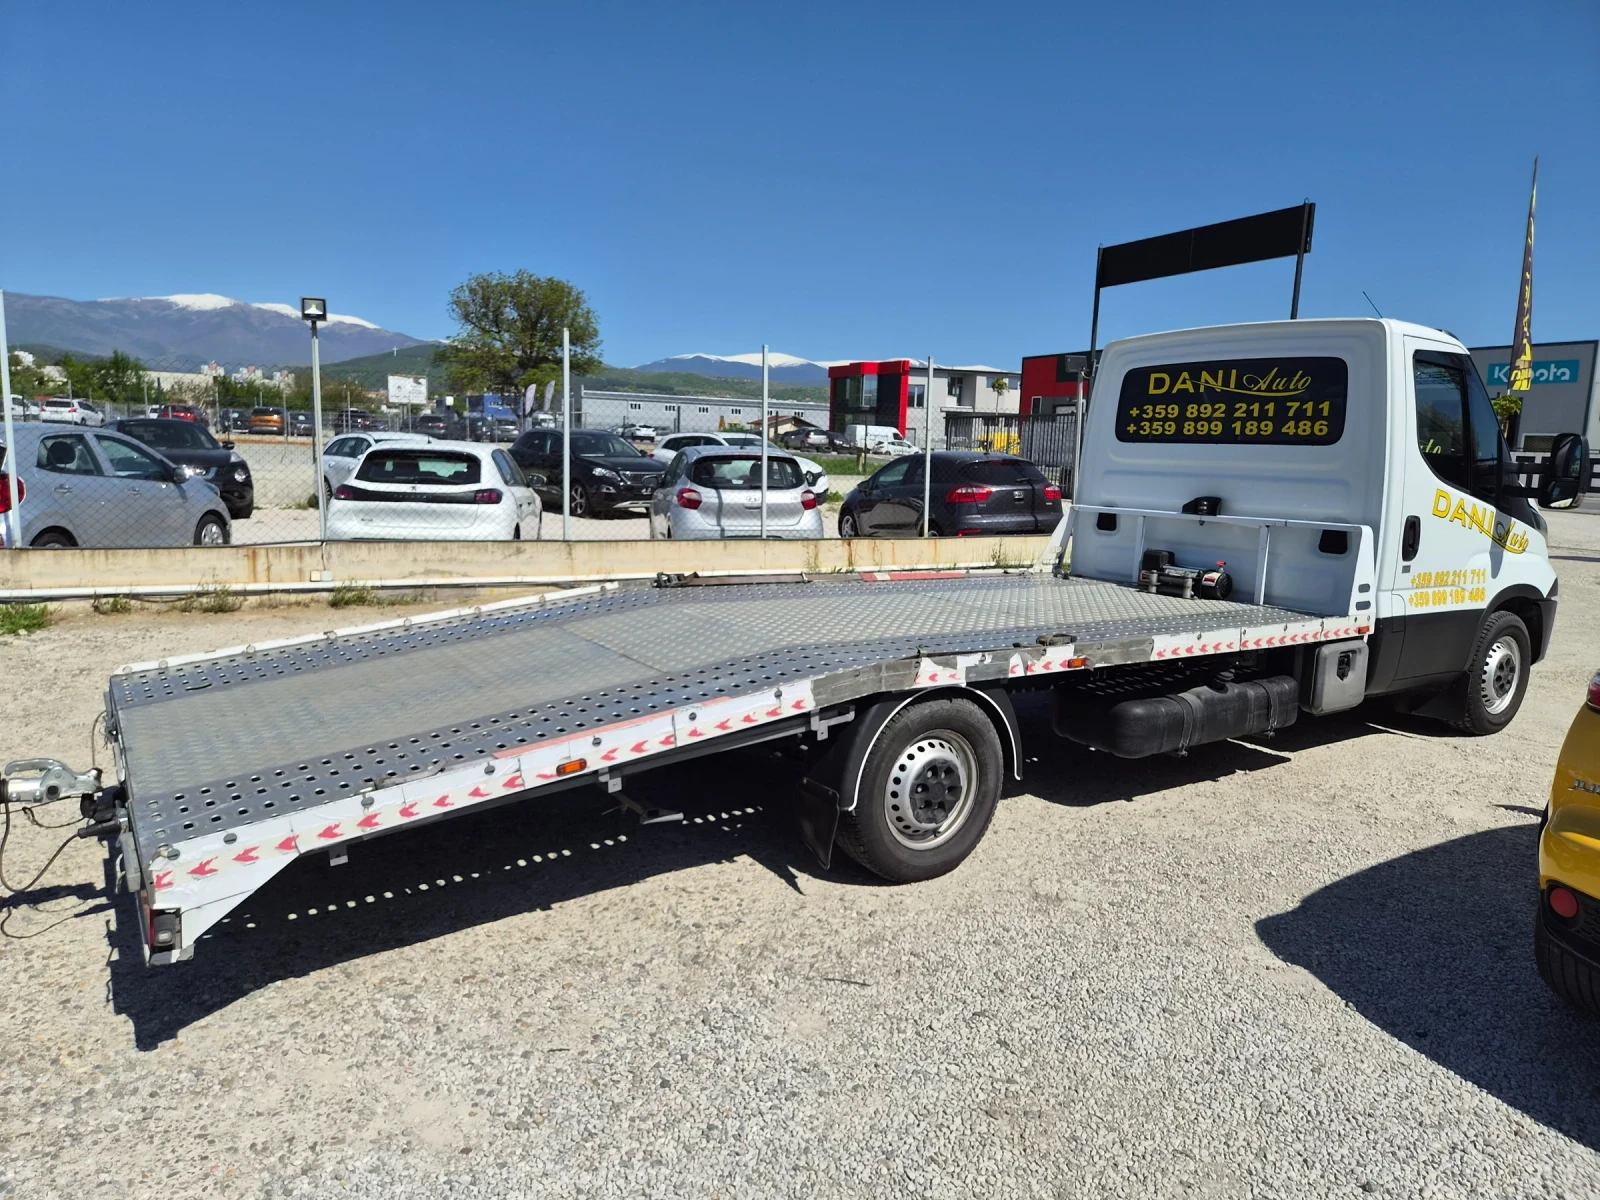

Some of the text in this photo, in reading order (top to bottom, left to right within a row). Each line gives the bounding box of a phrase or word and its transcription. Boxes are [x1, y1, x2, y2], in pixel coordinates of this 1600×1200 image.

[1148, 367, 1312, 395] DANI Auto
[1494, 364, 1570, 383] Kota
[1129, 401, 1330, 419] +359 892 211 711
[1126, 420, 1329, 436] +359 899 189 486
[1432, 488, 1529, 551] DANI Auto
[1410, 568, 1487, 589] +359 892 211 711
[1408, 587, 1487, 608] +359 899 189 486
